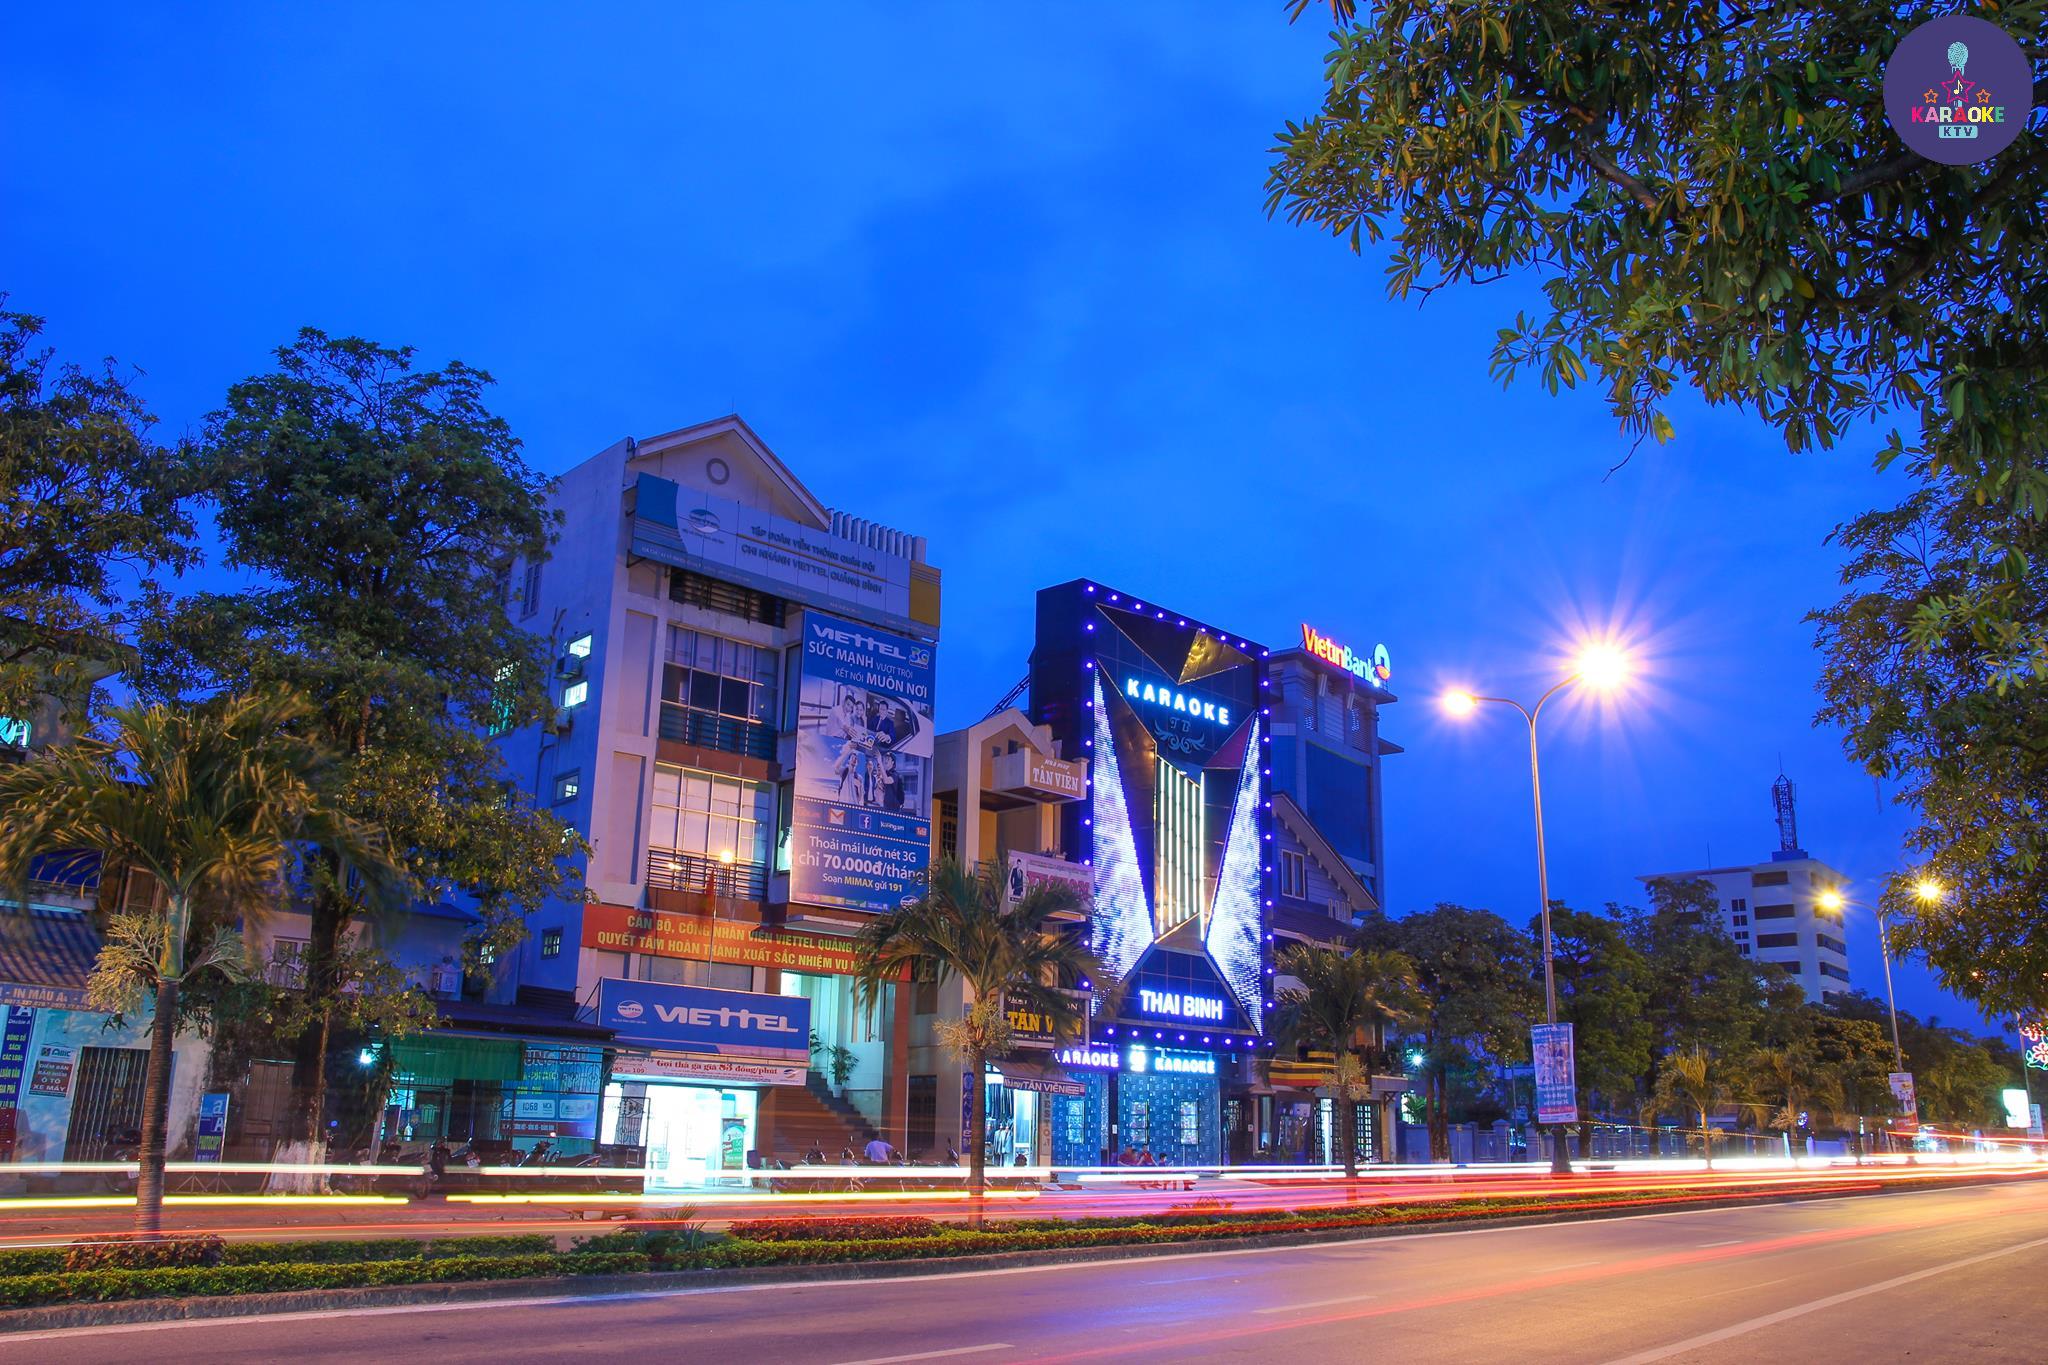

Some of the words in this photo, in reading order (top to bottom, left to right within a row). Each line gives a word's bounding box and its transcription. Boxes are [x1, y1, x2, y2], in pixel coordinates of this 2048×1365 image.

[741, 544, 758, 556] CHI
[793, 559, 829, 578] VIETTEL
[812, 623, 907, 660] VIETTEL
[1302, 623, 1375, 683] VietinBank
[808, 640, 834, 658] SỨC
[836, 648, 874, 668] MẠNH
[876, 662, 896, 676] VƯỢT
[897, 667, 913, 679] TRỘI
[835, 665, 848, 678] KẾT
[850, 668, 864, 682] NỐI
[866, 671, 904, 692] MUÔN
[906, 683, 928, 698] NƠI
[1127, 678, 1230, 726] KARAOKE
[1033, 765, 1054, 786] TÂN
[810, 836, 839, 851] Thoải
[841, 841, 862, 854] mái
[902, 850, 916, 863] 3G
[823, 873, 843, 885] Soạn
[844, 875, 873, 889] MIMAX
[874, 880, 887, 891] gửi
[888, 881, 903, 892] 191
[627, 914, 652, 929] CÁN
[678, 921, 711, 937] CÔNG
[713, 924, 745, 940] NHÂN
[748, 930, 773, 943] VIÊN
[776, 935, 815, 949] VIETTEL
[818, 937, 852, 952] QUẢNG
[597, 929, 636, 947] QUYẾT
[639, 935, 664, 950] TÂM
[668, 939, 700, 956] HOÀN
[703, 943, 740, 960] THÀNH
[743, 947, 771, 961] XUẤT
[774, 949, 795, 964] SẮC
[799, 955, 832, 970] NHIỆM
[835, 958, 848, 973] VỤ
[13, 988, 26, 999] IN
[1140, 990, 1180, 1015] THAI
[654, 1004, 799, 1032] VIETTEL
[1007, 1007, 1040, 1032] TÂN
[657, 1060, 672, 1069] Gọi
[1055, 1050, 1119, 1067] ARAOKE
[1155, 1057, 1215, 1074] KARAOKE
[46, 1084, 66, 1092] MÁY
[1023, 1080, 1041, 1091] TÂN
[1043, 1081, 1065, 1094] VIÊN
